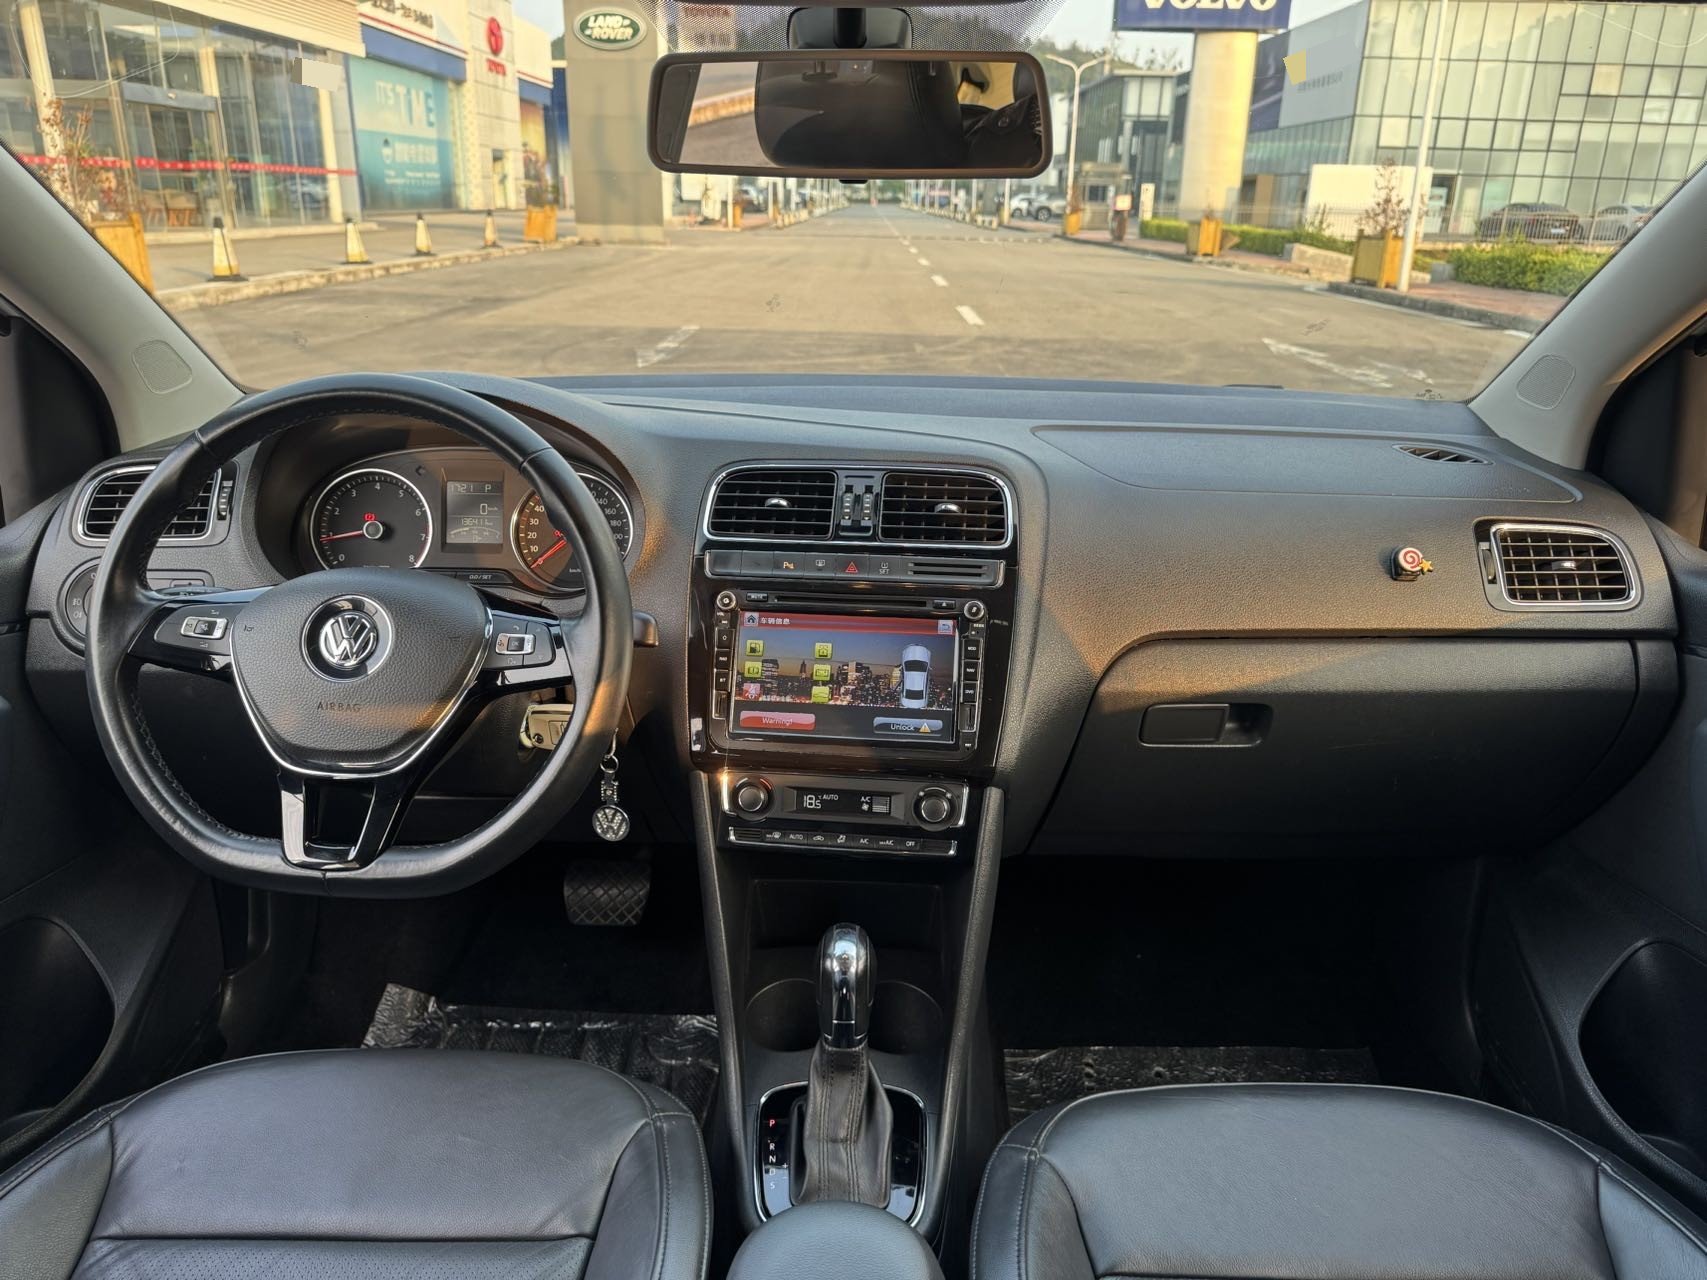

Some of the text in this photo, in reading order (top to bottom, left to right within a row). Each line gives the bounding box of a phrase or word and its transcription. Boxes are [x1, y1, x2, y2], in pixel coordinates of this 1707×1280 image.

[588, 15, 623, 28] LAND
[592, 28, 633, 40] ROVER
[375, 482, 381, 490] 4
[485, 484, 491, 493] P
[351, 489, 357, 497] 3
[399, 490, 404, 498] 5
[534, 504, 545, 512] 40
[415, 508, 422, 517] 6
[610, 519, 622, 527] 180
[420, 533, 426, 541] 7
[527, 531, 537, 539] 20
[529, 545, 538, 553] 10
[338, 553, 345, 561] 0
[408, 554, 415, 563] 8
[317, 702, 361, 712] AIRBAG
[762, 717, 793, 726] Warning!
[890, 722, 915, 731] Unlock
[769, 1119, 775, 1128] P
[769, 1142, 775, 1150] R
[769, 1155, 776, 1163] N
[769, 1168, 775, 1176] D
[770, 1182, 775, 1190] S
